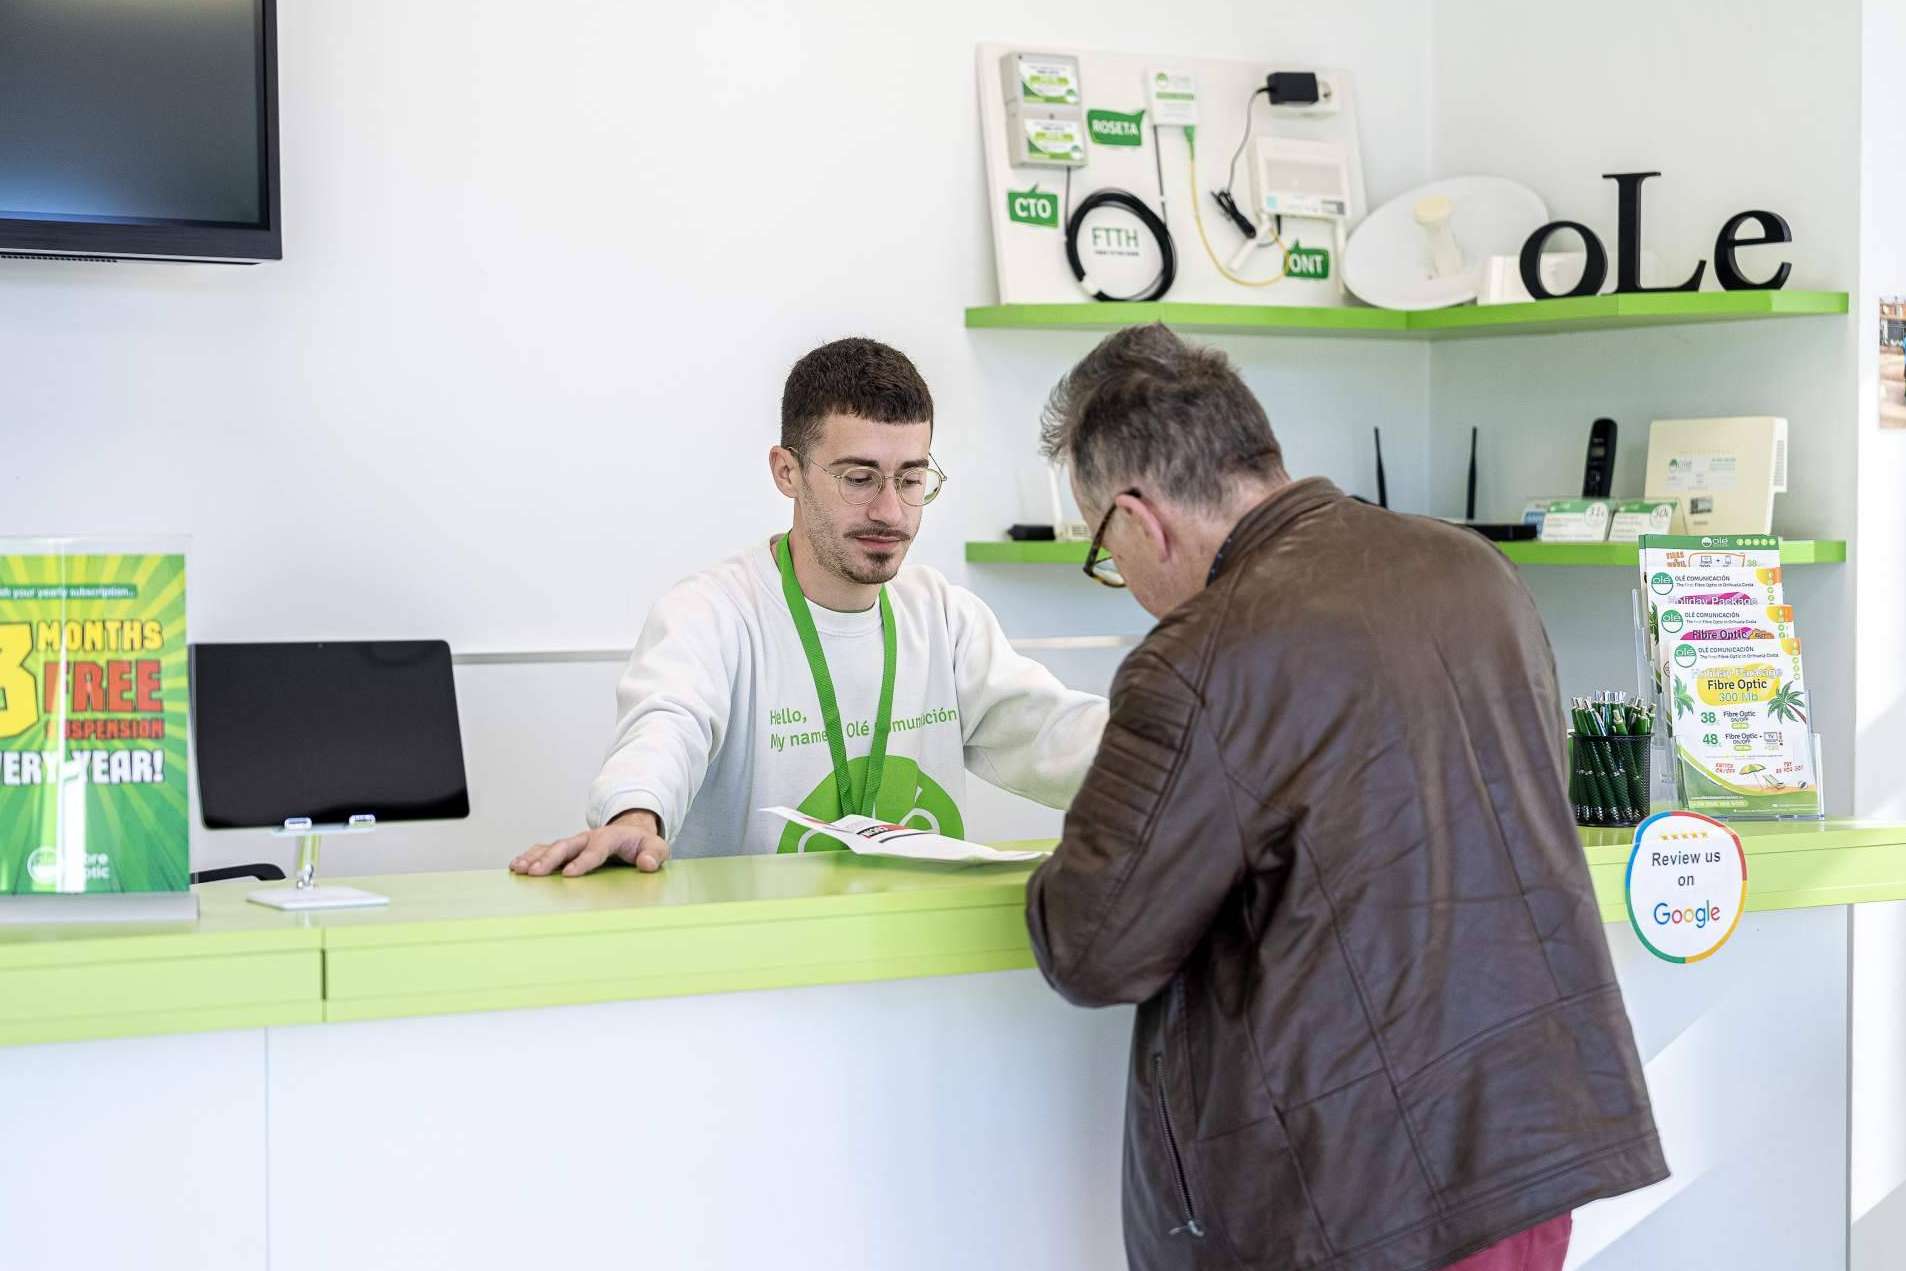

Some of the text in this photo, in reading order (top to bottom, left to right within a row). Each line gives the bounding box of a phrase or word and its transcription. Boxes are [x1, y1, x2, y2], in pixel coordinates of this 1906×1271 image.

[1092, 120, 1139, 136] ROSETA
[1015, 198, 1052, 219] CTO
[1092, 227, 1139, 247] FTTH
[1288, 253, 1324, 274] ONT
[36, 620, 164, 653] MONTHS
[1692, 630, 1717, 640] Fibre
[1720, 630, 1747, 640] Optic
[44, 660, 165, 713] FREE
[1708, 679, 1767, 690] Fibre Optic
[770, 708, 807, 726] Hello,
[1700, 712, 1716, 723] 38
[770, 733, 785, 752] My
[790, 729, 828, 747] name
[846, 719, 870, 738] Olé
[1703, 734, 1718, 745] 48
[72, 748, 165, 785] YEAR!
[1652, 851, 1721, 867] Review us
[1678, 875, 1694, 886] on
[1653, 900, 1721, 929] Google
